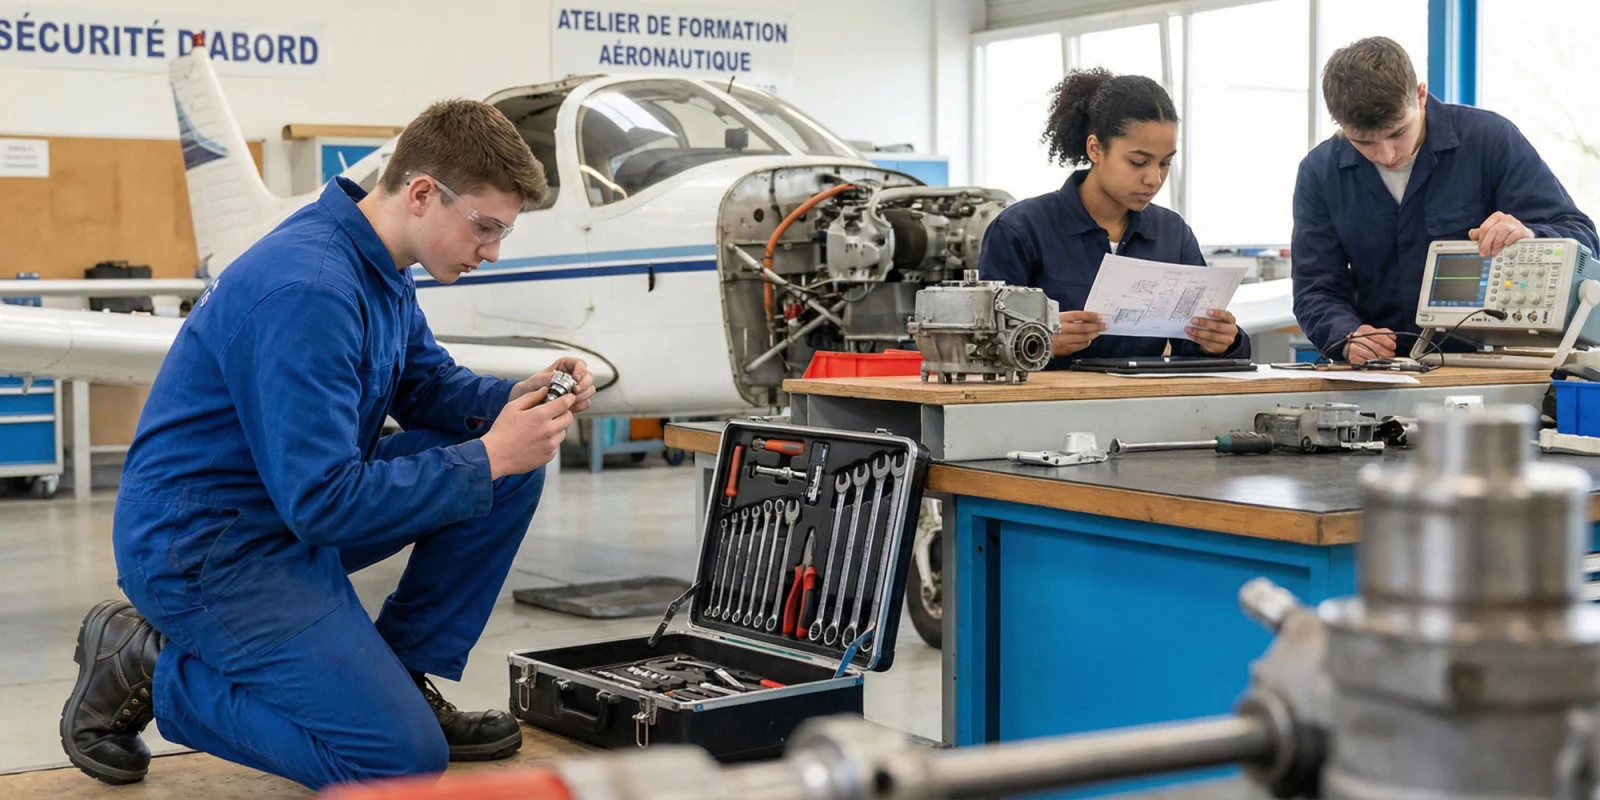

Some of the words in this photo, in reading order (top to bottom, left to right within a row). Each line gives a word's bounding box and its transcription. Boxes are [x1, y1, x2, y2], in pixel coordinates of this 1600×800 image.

[0, 12, 165, 58] SÉCURITÉ
[558, 9, 640, 34] ATELIER
[647, 15, 671, 36] DE
[678, 17, 788, 43] FORMATION
[599, 40, 751, 72] AÉRONAUTIQUE
